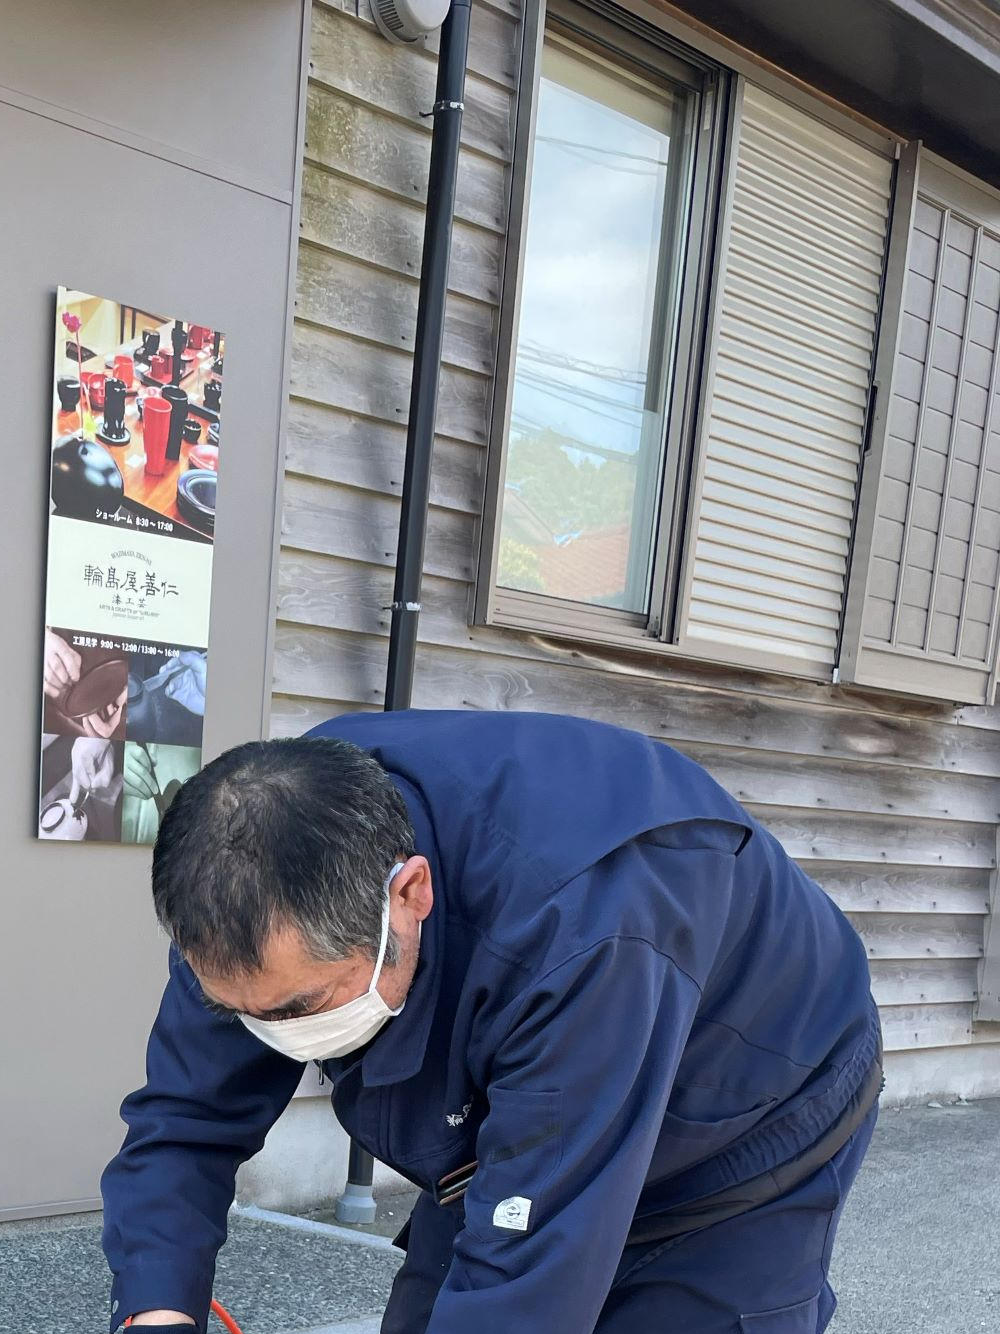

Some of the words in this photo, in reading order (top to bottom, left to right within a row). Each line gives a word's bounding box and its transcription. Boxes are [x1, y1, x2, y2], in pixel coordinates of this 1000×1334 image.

[95, 508, 133, 524] ショールーム
[83, 564, 179, 598] 輪島屋善仁
[112, 593, 147, 608] 漆工芸
[72, 635, 98, 648] 工房見学
